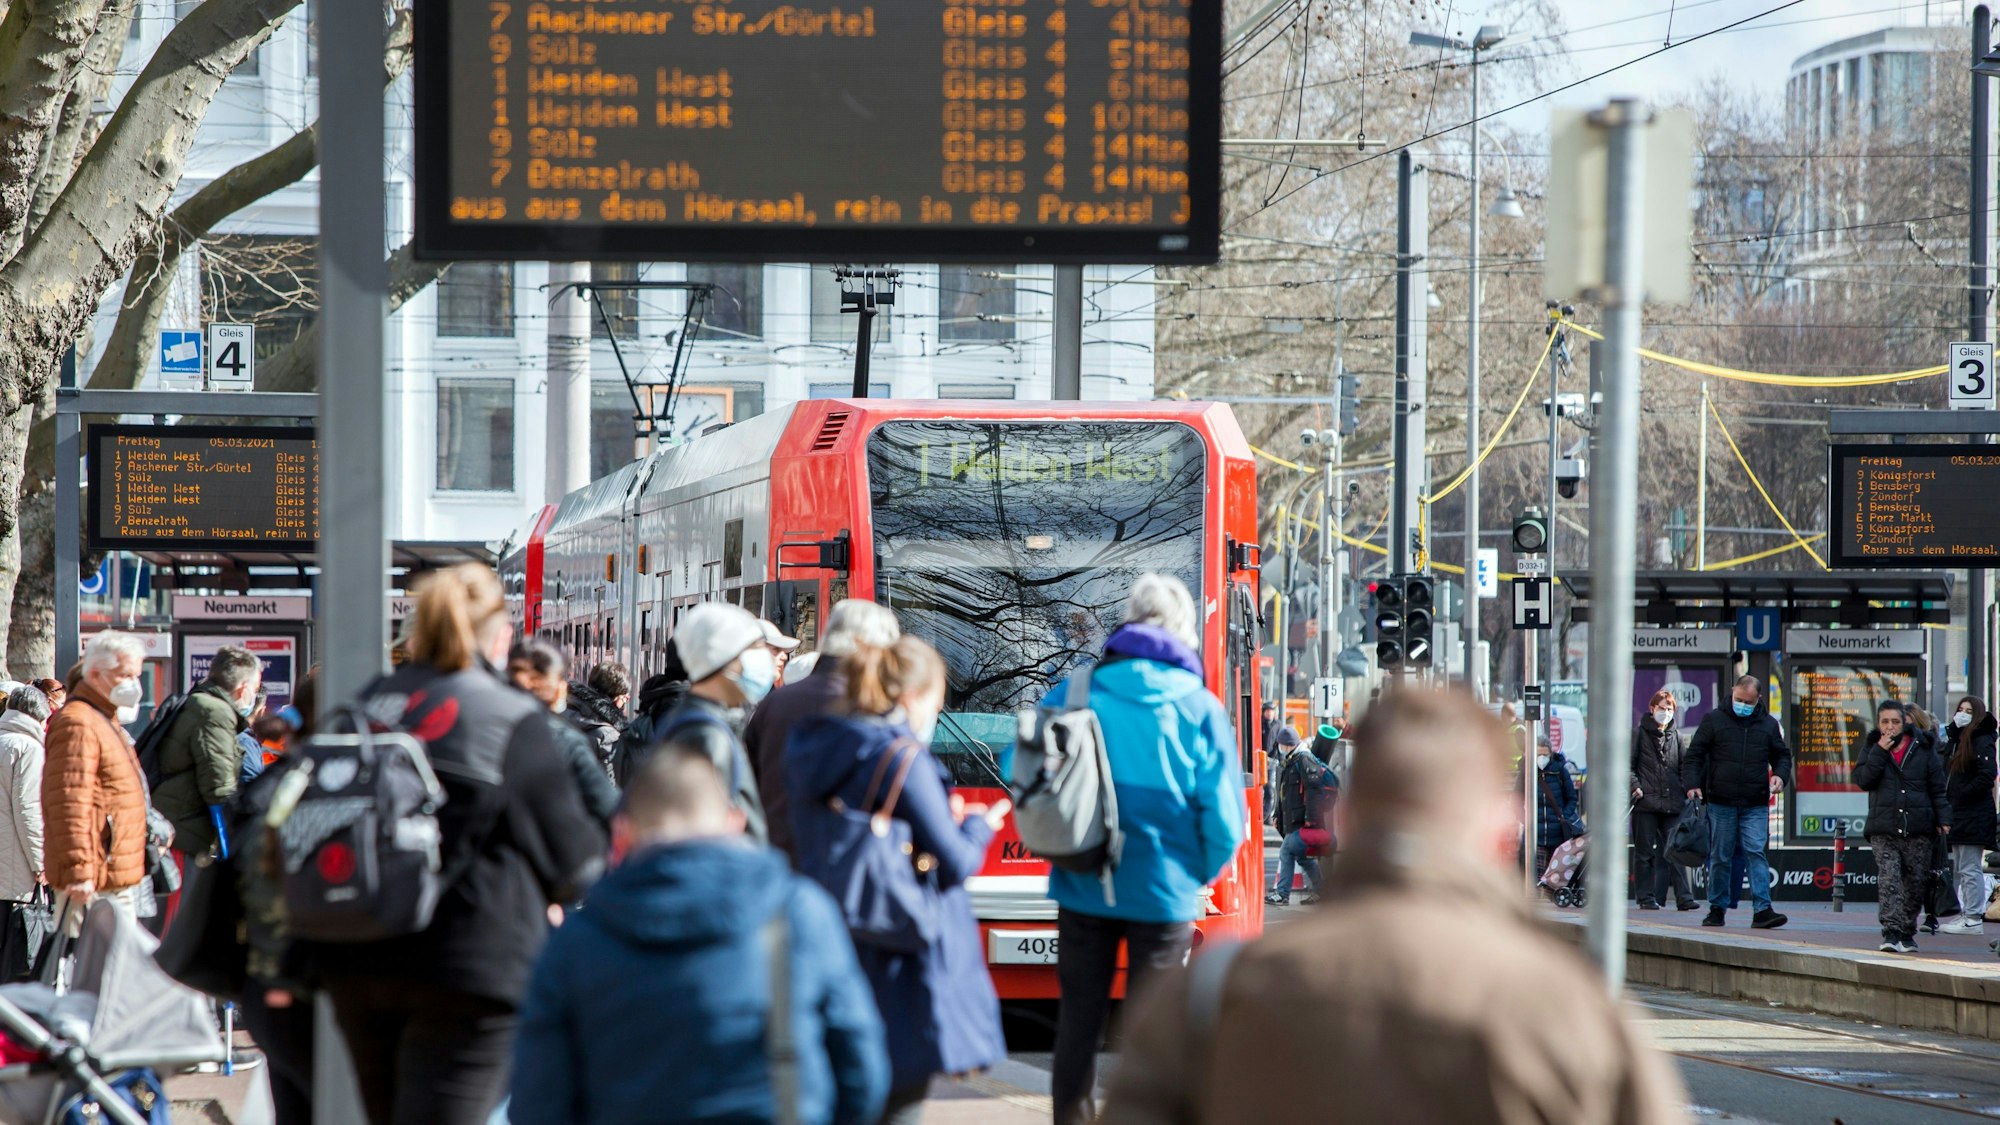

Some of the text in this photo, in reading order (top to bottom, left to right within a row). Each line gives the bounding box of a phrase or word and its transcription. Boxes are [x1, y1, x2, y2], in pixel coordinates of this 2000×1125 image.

[488, 2, 511, 31] 7
[527, 3, 674, 35] Aachener
[943, 7, 1027, 38] Gleis
[1044, 8, 1067, 36] 4
[488, 34, 511, 64] 9
[943, 38, 1027, 69] Gleis
[1044, 39, 1067, 68] 4
[492, 66, 508, 95] 1
[528, 65, 638, 96] Weiden
[656, 66, 733, 97] West
[943, 70, 1027, 100] Gleis
[1044, 70, 1066, 99] 4
[492, 97, 508, 127] 1
[528, 96, 638, 128] Weiden
[656, 97, 733, 129] West
[942, 101, 1027, 131] Gleis
[1044, 102, 1066, 130] 4
[488, 127, 512, 158] 9
[942, 131, 1026, 162] Gleis
[1044, 133, 1065, 161] 4
[489, 158, 511, 188] 7
[942, 162, 1026, 193] Gleis
[1043, 163, 1065, 192] 4
[525, 197, 581, 220] aus
[600, 191, 667, 221] dem
[835, 195, 901, 223] rein
[920, 195, 952, 223] in
[970, 195, 1020, 224] die
[219, 328, 244, 338] Gleis
[1959, 347, 1984, 357] Gleis
[216, 342, 246, 376] 4
[1958, 358, 1985, 395] 3
[117, 435, 275, 449] Freitag 05.03.2021
[115, 451, 121, 460] 1
[128, 451, 167, 461] Weiden
[174, 451, 200, 461] West
[276, 453, 305, 463] Gleis
[951, 440, 1072, 482] Weiden
[1086, 441, 1173, 482] West
[1860, 456, 1903, 468] Freitag
[115, 461, 122, 470] 7
[128, 461, 179, 472] Aachener
[186, 462, 252, 473] Str./Gürtel
[276, 463, 305, 473] Gleis
[114, 472, 122, 482] 9
[128, 472, 152, 482] Sülz
[276, 474, 305, 484] Gleis
[1857, 470, 1936, 482] 9 Königsforst
[115, 483, 121, 493] 1
[128, 483, 167, 494] Weiden
[174, 484, 200, 494] West
[276, 485, 305, 495] Gleis
[1858, 481, 1921, 493] 1 Bensberg
[115, 494, 121, 504] 1
[128, 494, 167, 504] Weiden
[174, 495, 200, 504] West
[276, 496, 305, 506] Gleis
[1857, 491, 1914, 503] 7 Zündorf
[114, 505, 122, 515] 9
[128, 505, 152, 515] Sülz
[276, 507, 305, 517] Gleis
[1858, 502, 1921, 514] 1 Bensberg
[114, 516, 122, 525] 7
[128, 516, 188, 526] Benzelrath
[275, 518, 305, 528] Gleis
[1856, 512, 1932, 522] E Porz Markt
[121, 527, 148, 536] Raus
[155, 528, 174, 537] aus
[181, 527, 204, 537] dem
[211, 528, 258, 539] Hörsaal,
[265, 529, 289, 538] rein
[295, 529, 307, 539] in
[1856, 523, 1936, 535] 9 Königsforst
[1856, 534, 1914, 546] 7 Zündorf
[1862, 544, 1998, 556] Raus aus dem Hörsaal,
[204, 599, 278, 615] Neumarkt
[1515, 582, 1550, 625] H
[1746, 614, 1771, 645] U
[1818, 634, 1891, 649] Neumarkt
[1002, 841, 1034, 859] KV
[1783, 870, 1814, 885] KVB
[1845, 872, 1879, 885] Ticke
